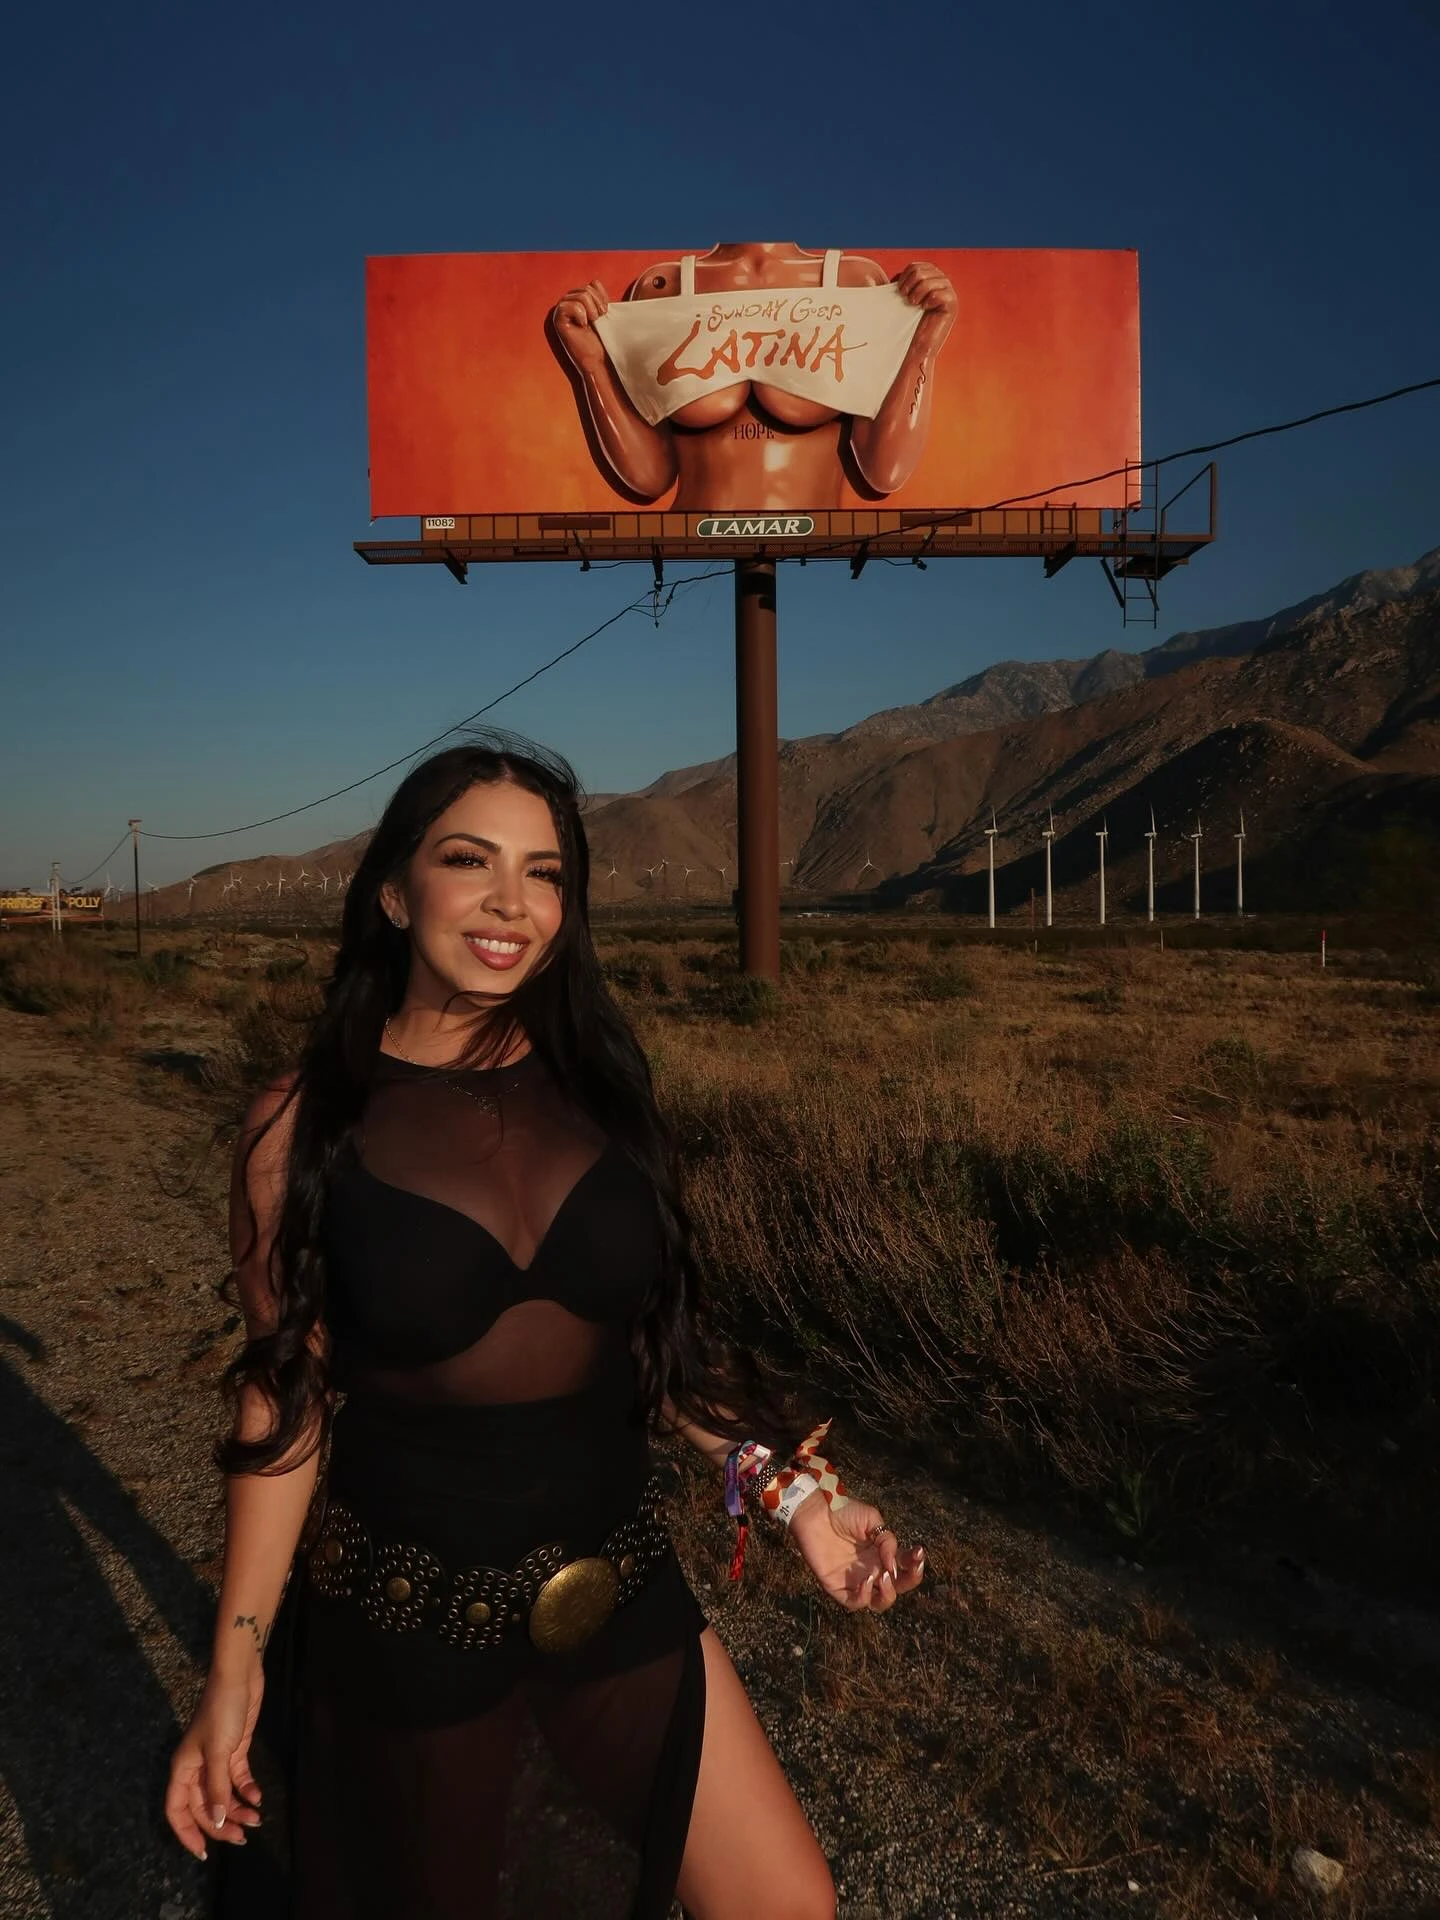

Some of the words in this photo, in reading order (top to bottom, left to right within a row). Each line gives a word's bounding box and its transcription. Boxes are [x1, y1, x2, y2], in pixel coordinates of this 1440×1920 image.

[707, 299, 788, 332] SUNDAY
[656, 317, 868, 386] LATINA
[734, 422, 775, 440] HOPE
[427, 518, 454, 527] 11082
[711, 519, 800, 535] LAMAR
[69, 896, 101, 908] POLLY
